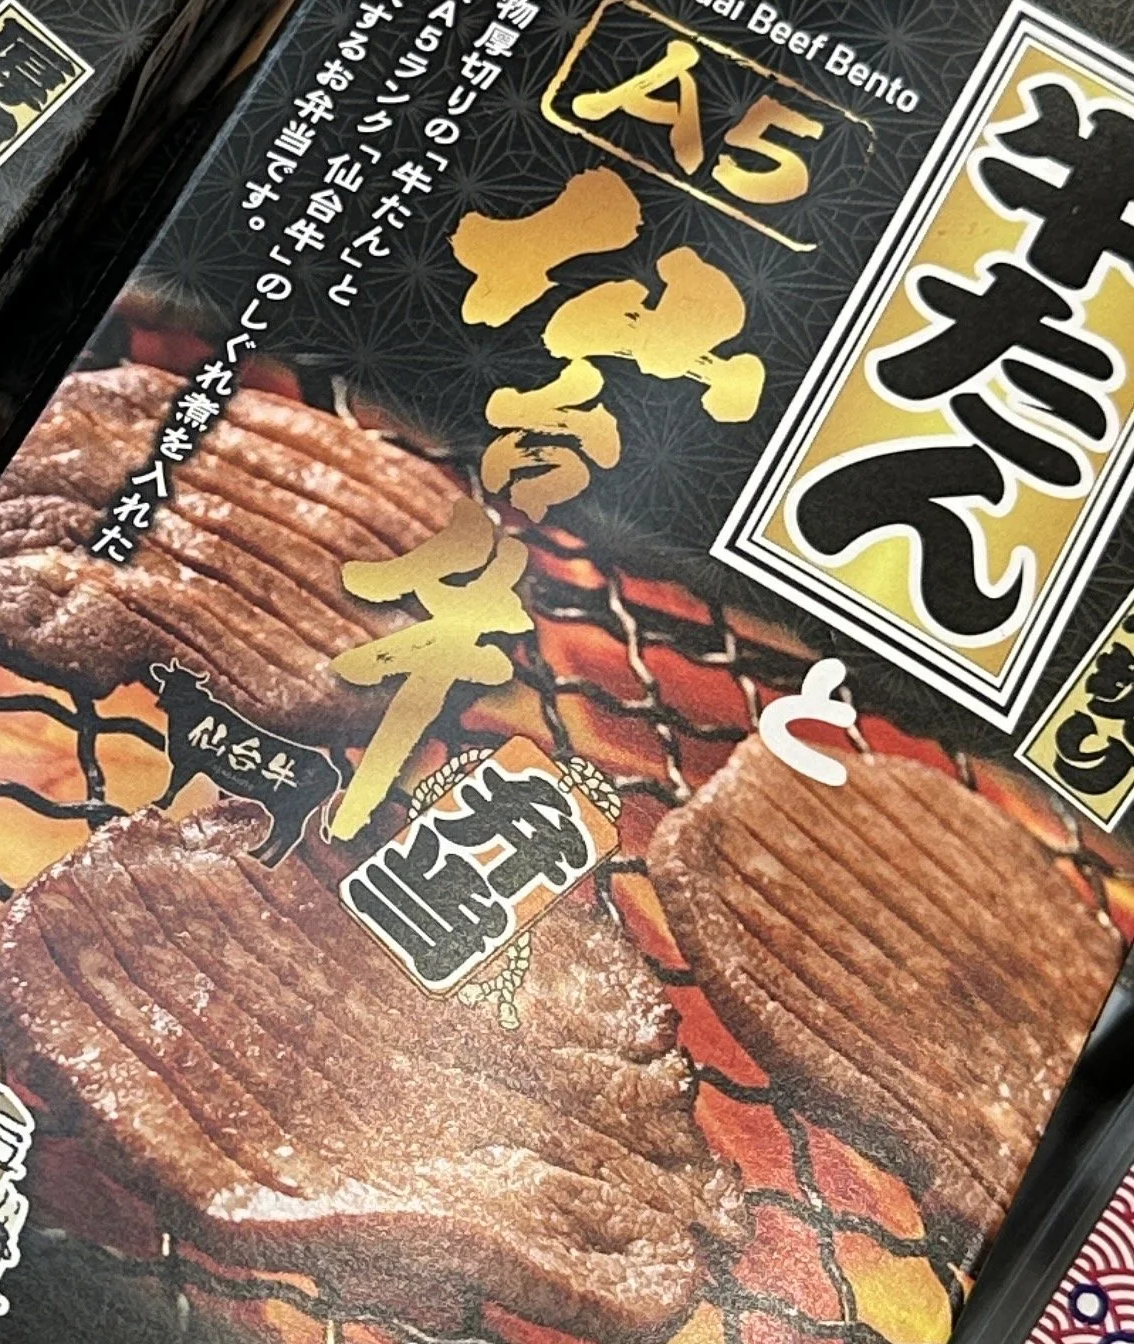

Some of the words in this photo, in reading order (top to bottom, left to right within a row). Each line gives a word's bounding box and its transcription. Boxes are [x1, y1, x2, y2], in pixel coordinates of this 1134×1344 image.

[571, 39, 824, 205] A5
[746, 1, 829, 62] Beef
[823, 48, 921, 116] Bento
[187, 715, 298, 793] 仙台牛
[759, 657, 858, 787] と
[347, 761, 589, 987] 弁当
